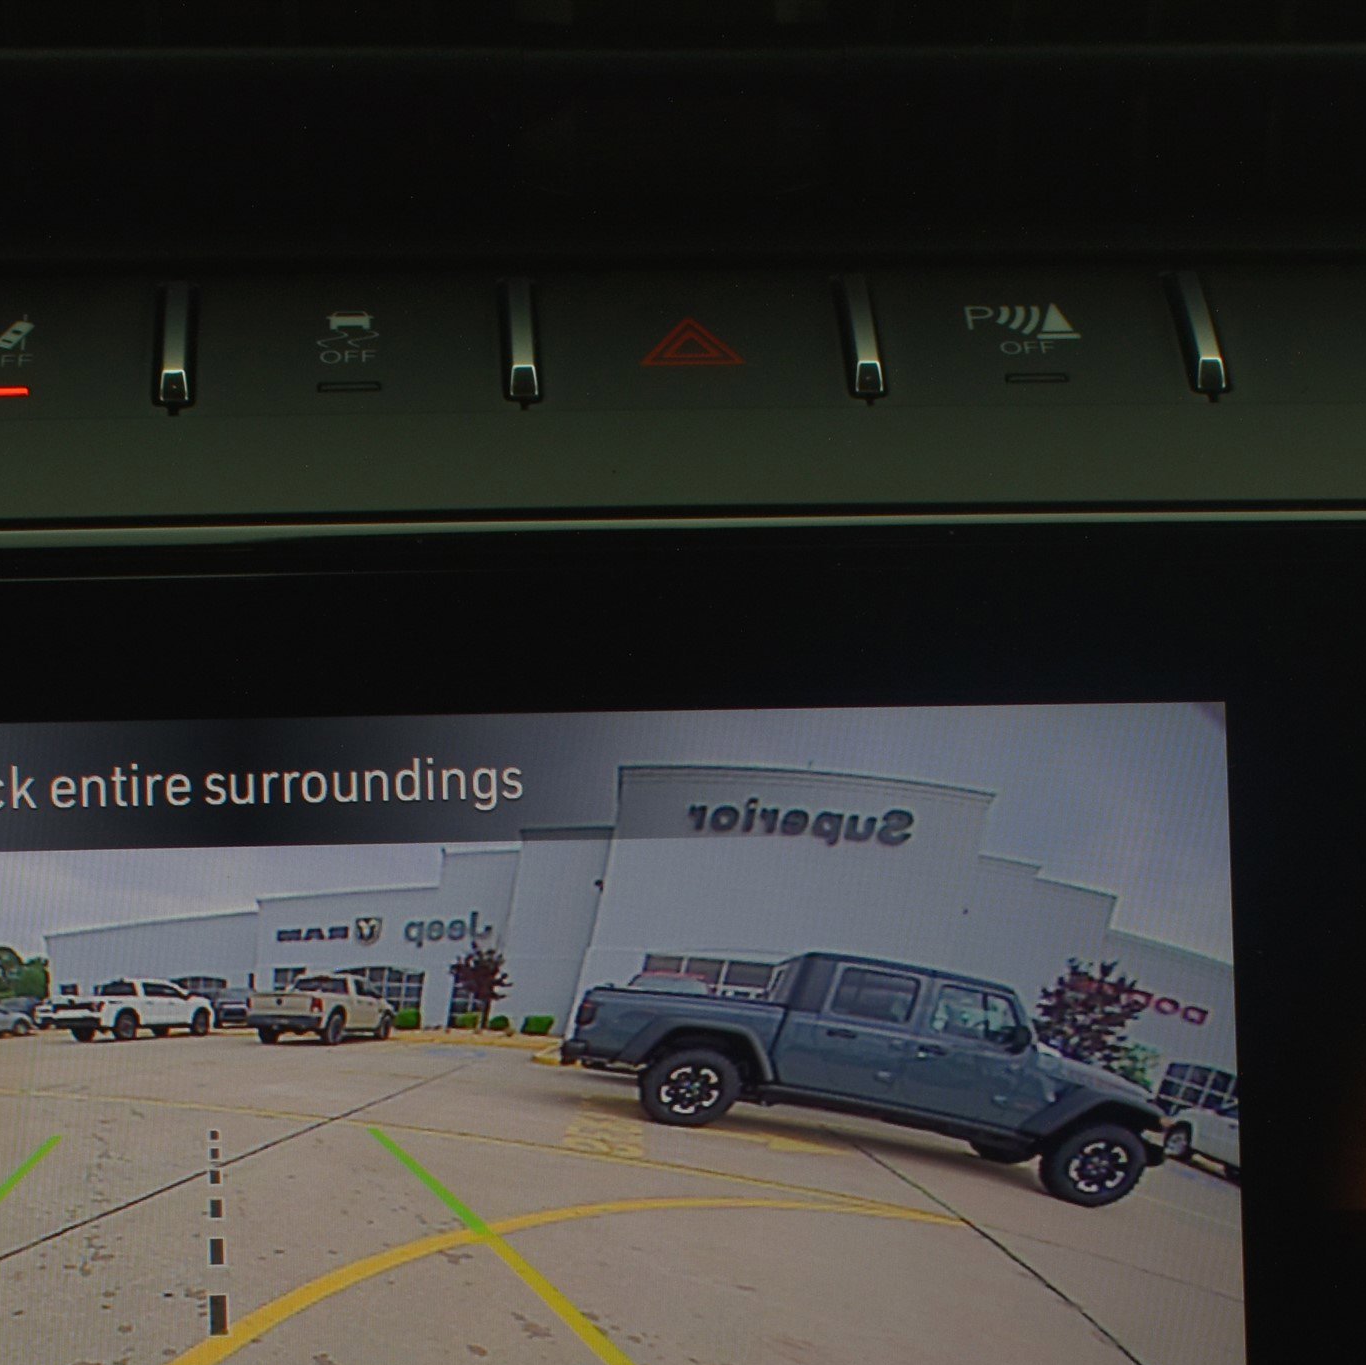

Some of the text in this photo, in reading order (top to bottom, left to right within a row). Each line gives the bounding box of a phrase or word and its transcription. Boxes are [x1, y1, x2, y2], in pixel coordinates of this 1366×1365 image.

[964, 305, 995, 331] P
[318, 349, 378, 365] OFF
[999, 340, 1055, 355] OFF
[50, 764, 193, 809] entire
[205, 758, 525, 813] surroundings
